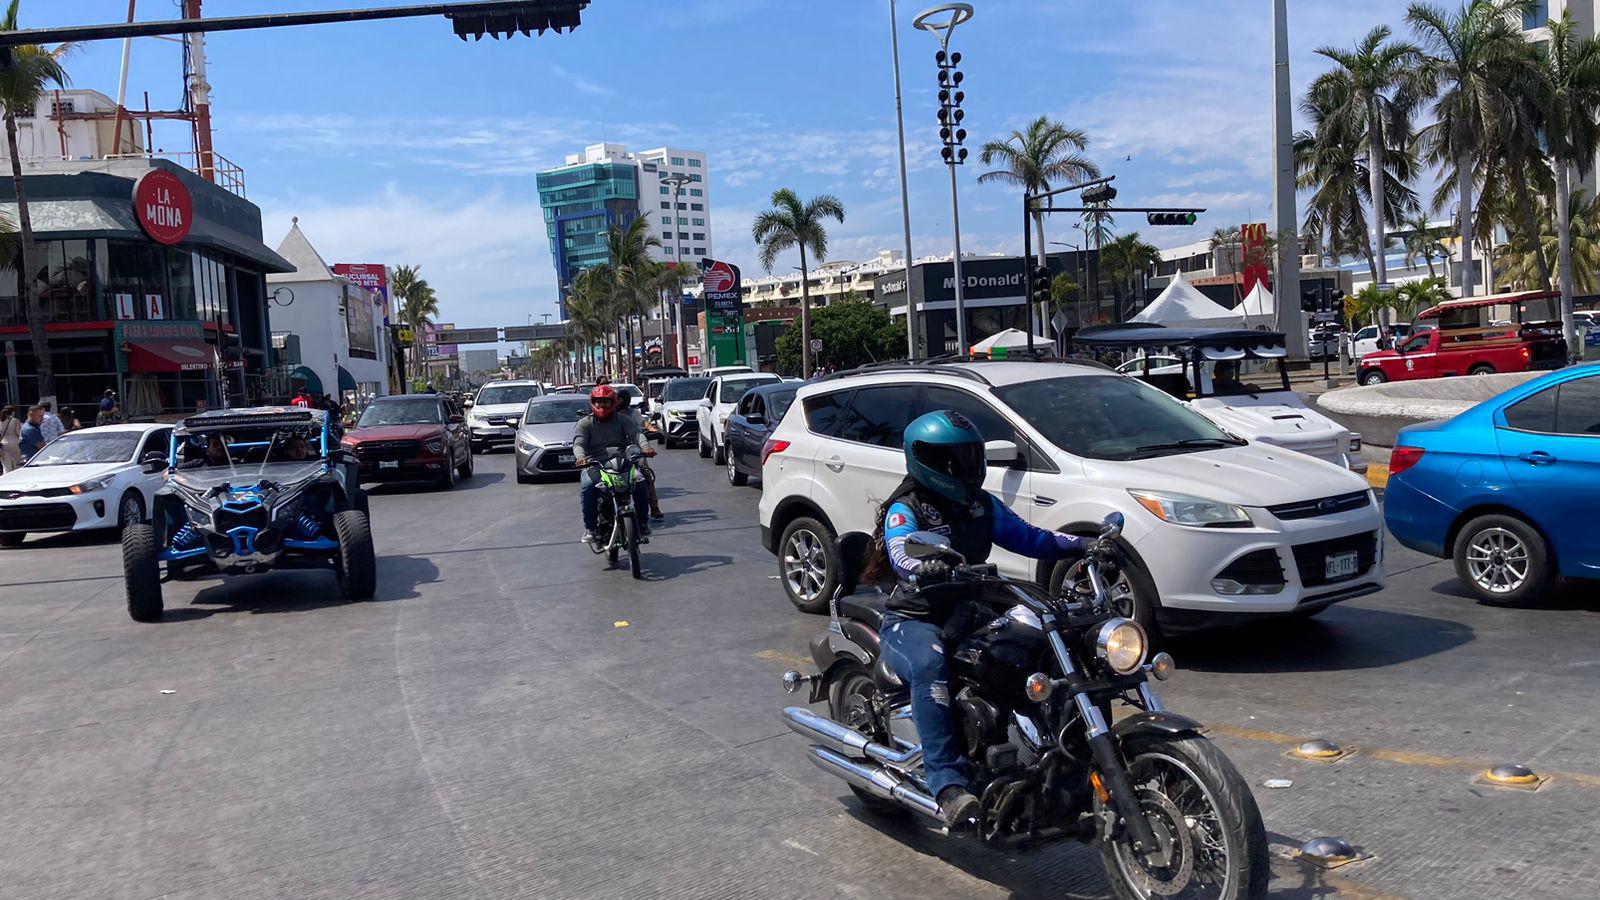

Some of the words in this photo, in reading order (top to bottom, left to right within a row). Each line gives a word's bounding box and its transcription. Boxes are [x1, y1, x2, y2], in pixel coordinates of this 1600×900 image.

[157, 187, 171, 205] LA
[146, 203, 182, 228] MONA
[707, 292, 738, 300] PEMEX
